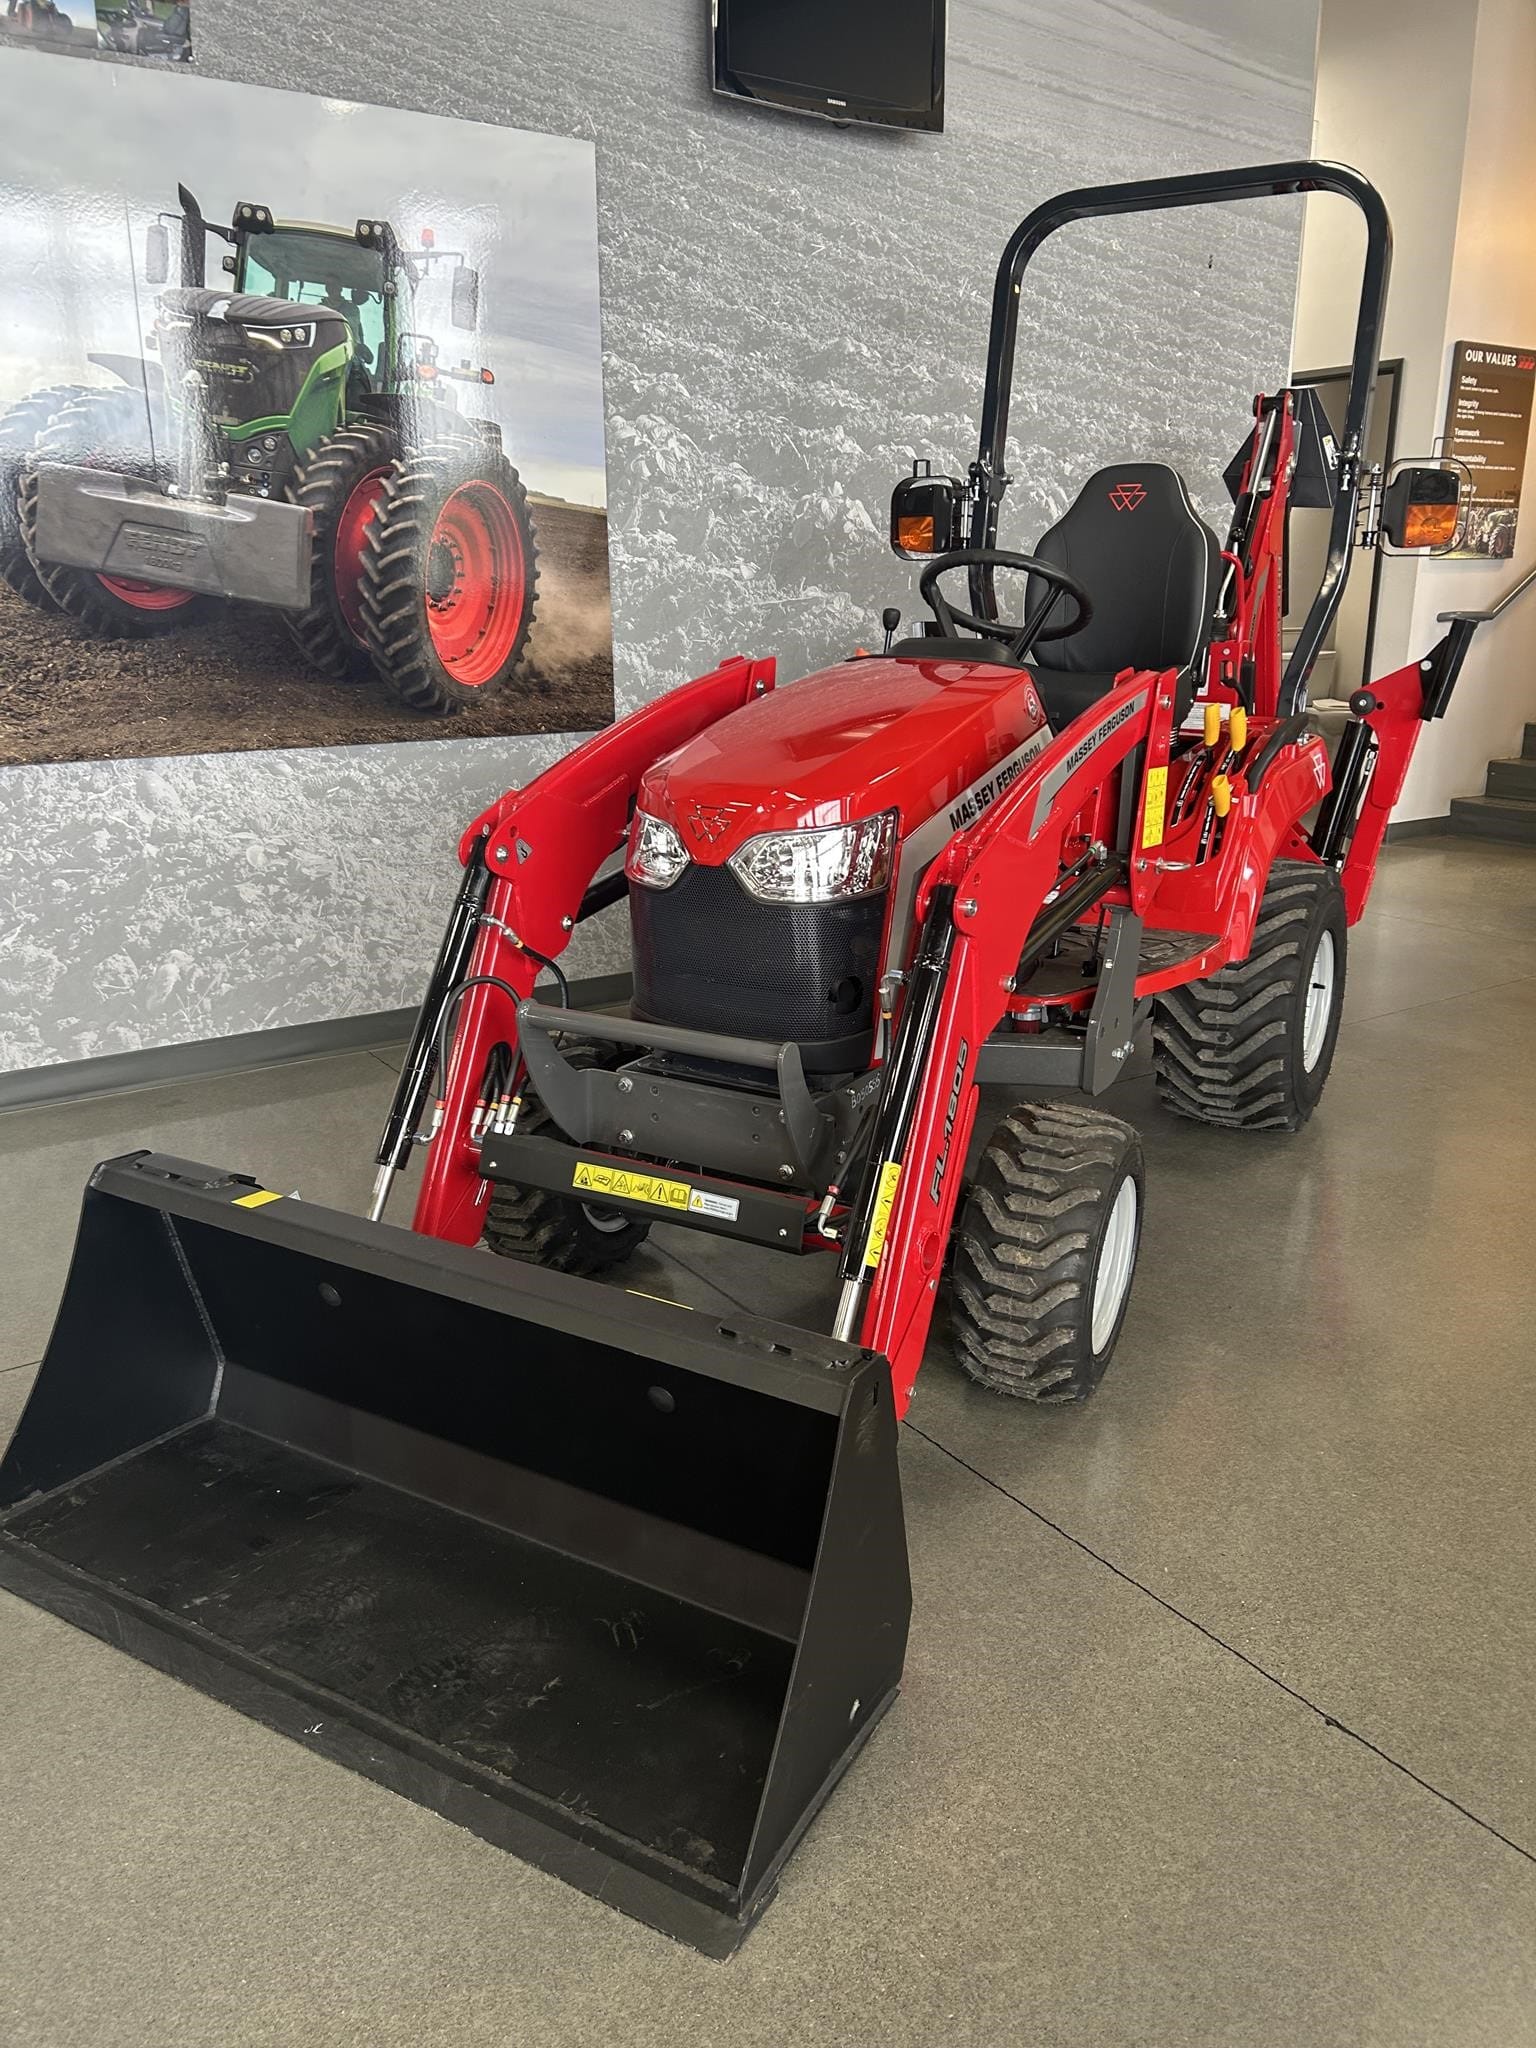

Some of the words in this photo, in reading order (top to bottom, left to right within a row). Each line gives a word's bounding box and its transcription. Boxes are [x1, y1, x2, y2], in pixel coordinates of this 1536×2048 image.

[1465, 349, 1484, 363] OUR
[1485, 351, 1517, 367] VALUES
[1461, 375, 1478, 386] Safety
[1458, 398, 1480, 409] Integrity
[1454, 427, 1480, 437] Teamwork
[1066, 732, 1099, 773] MASSEY
[1098, 700, 1136, 743] FERGUSON
[948, 779, 996, 832] MASSEY
